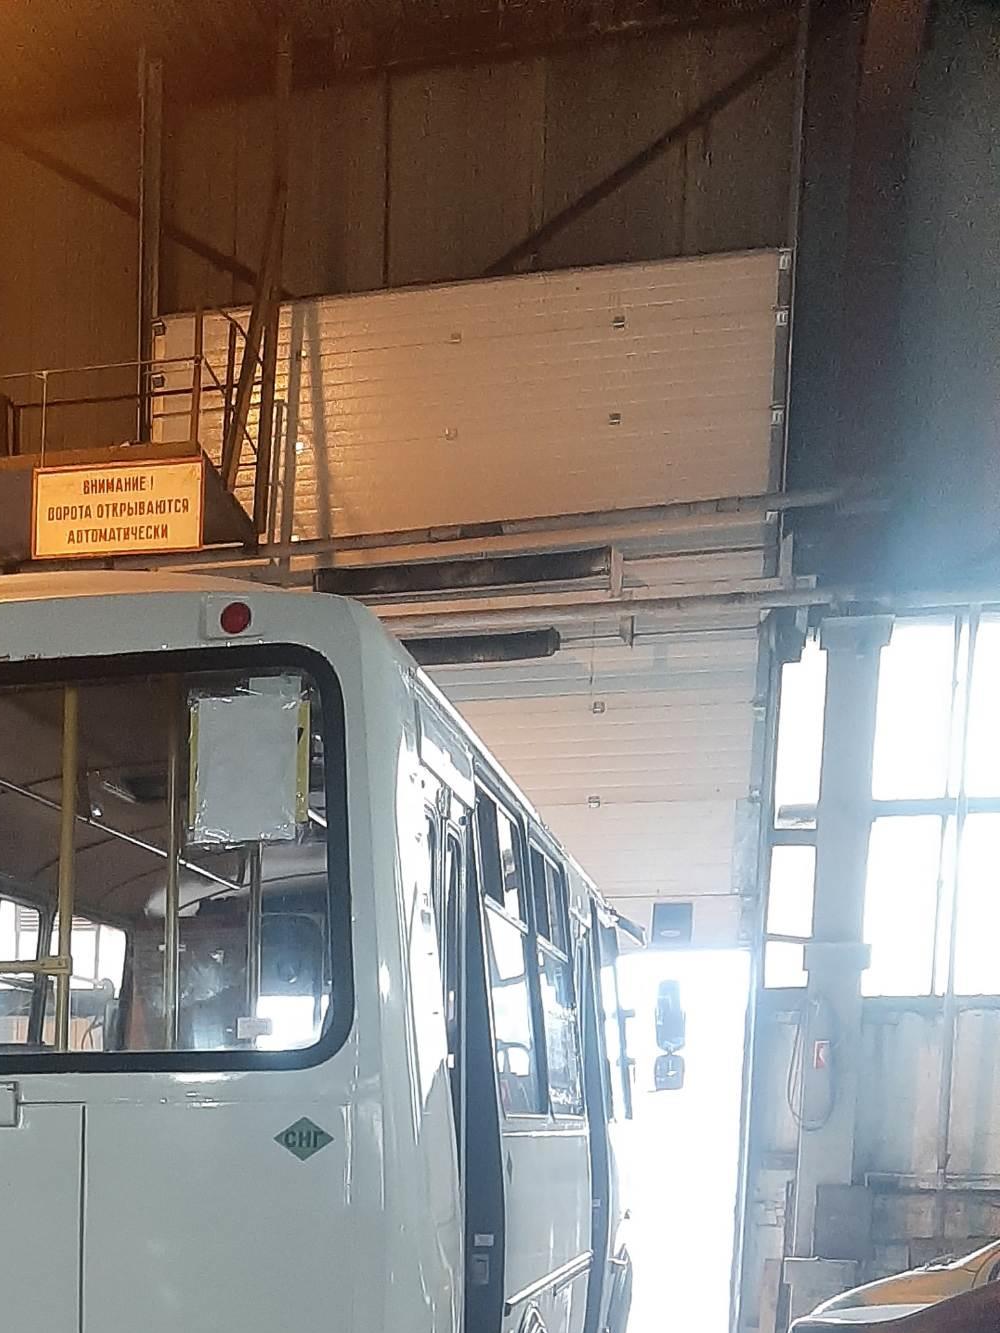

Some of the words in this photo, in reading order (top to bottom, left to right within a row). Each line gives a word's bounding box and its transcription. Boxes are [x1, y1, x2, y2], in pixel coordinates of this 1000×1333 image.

[47, 505, 92, 521] ВОРОТА
[96, 498, 189, 519] ОТКРЫВАЮТСЯ
[67, 524, 168, 544] АВТОМАТИЧЕСКИ
